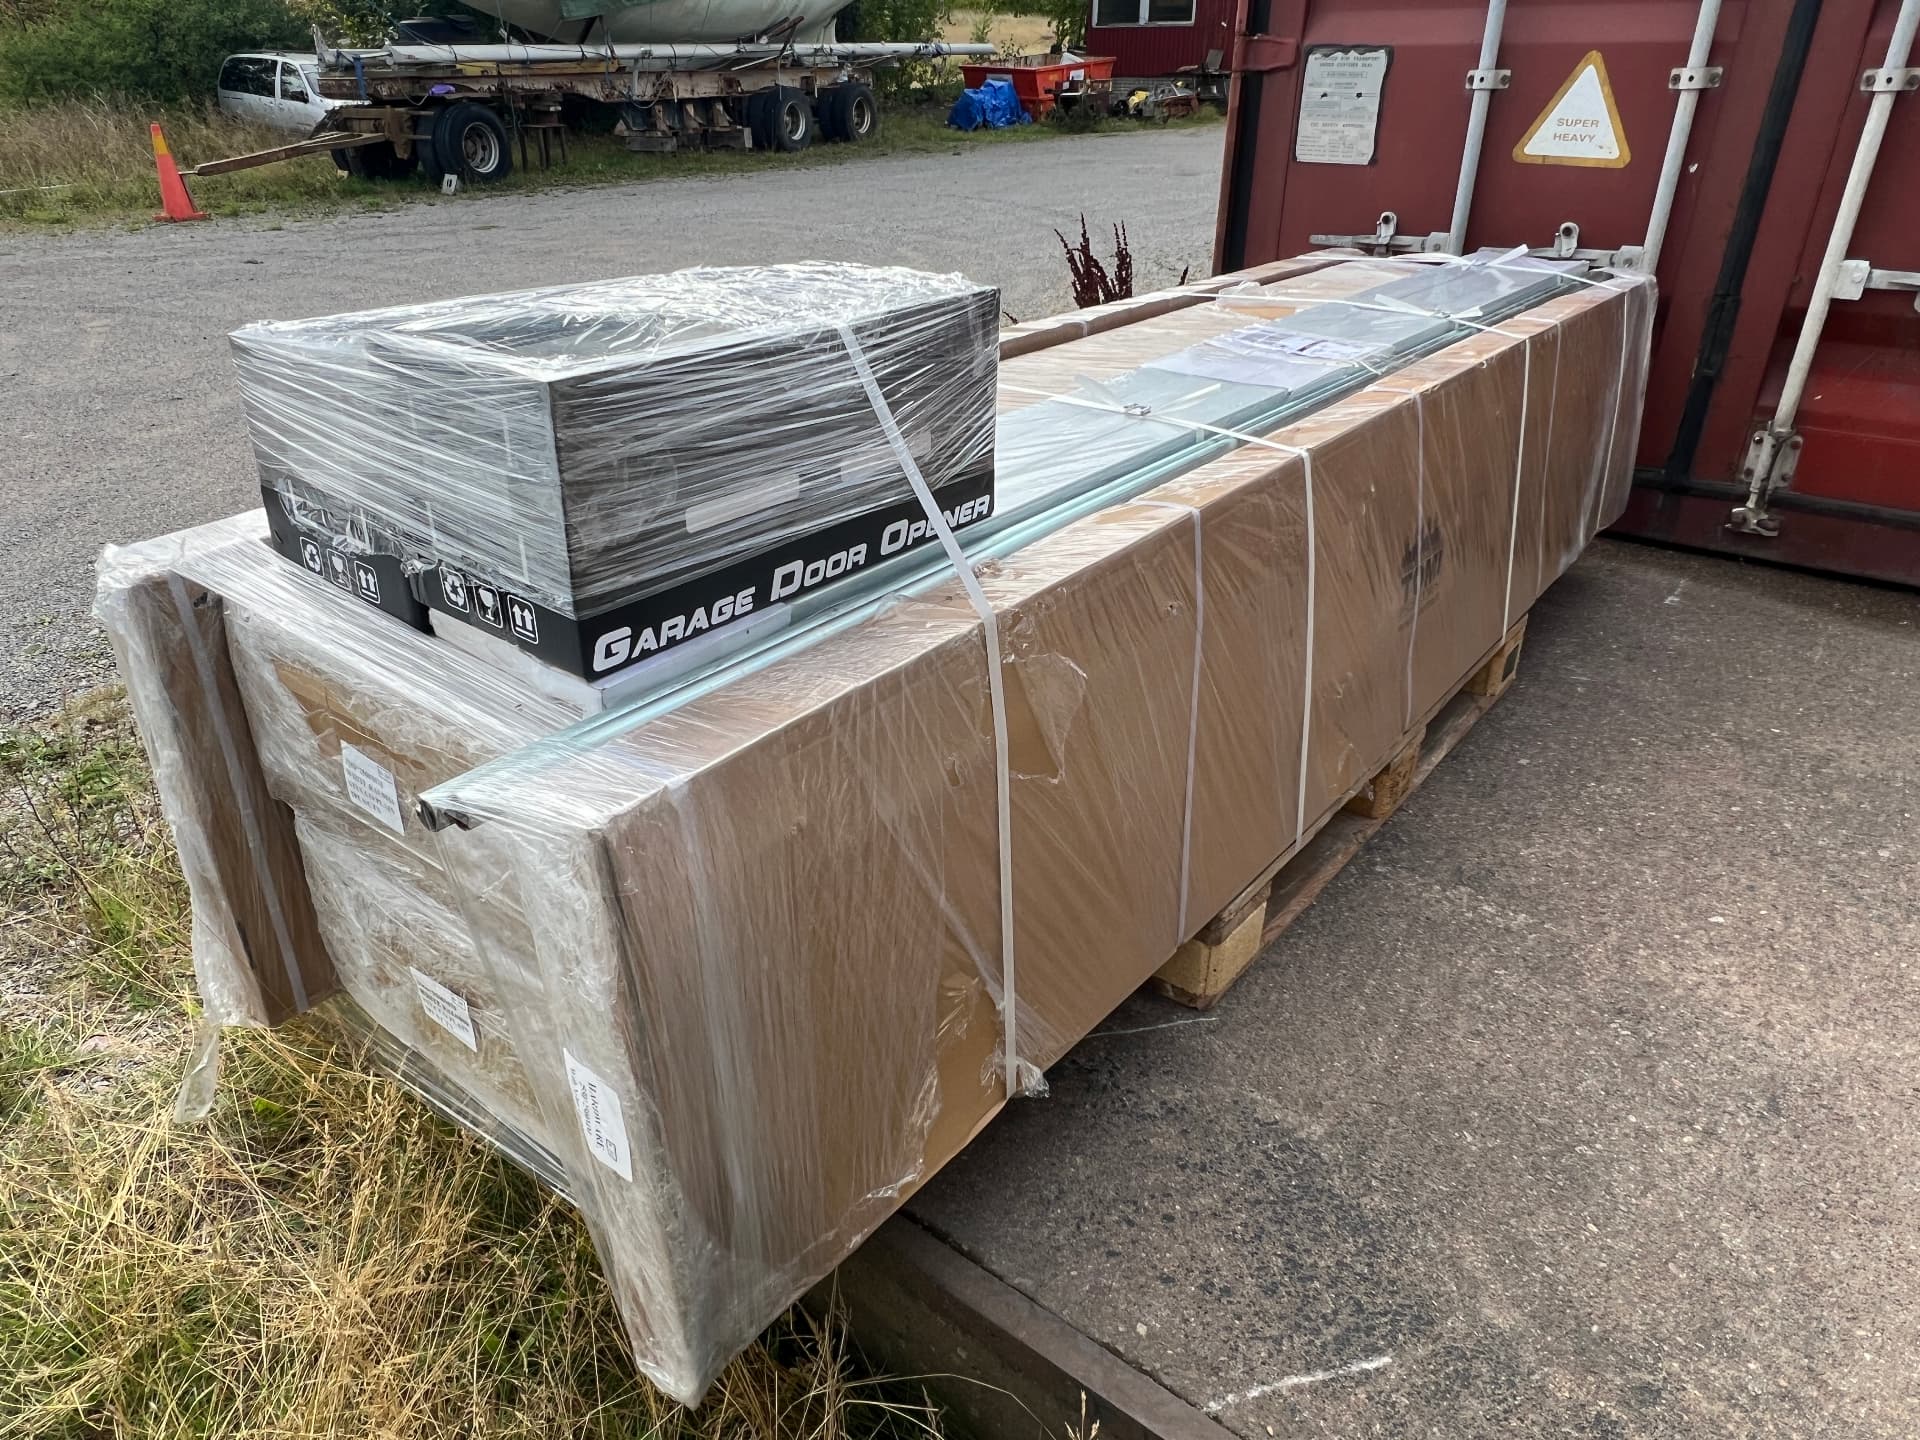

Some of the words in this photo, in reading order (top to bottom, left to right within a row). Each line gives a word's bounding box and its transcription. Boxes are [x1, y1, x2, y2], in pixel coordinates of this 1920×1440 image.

[1557, 118, 1600, 128] SUPER
[1553, 133, 1596, 143] HEAVY
[592, 585, 756, 672] GARAGE
[769, 542, 867, 602] DOOR
